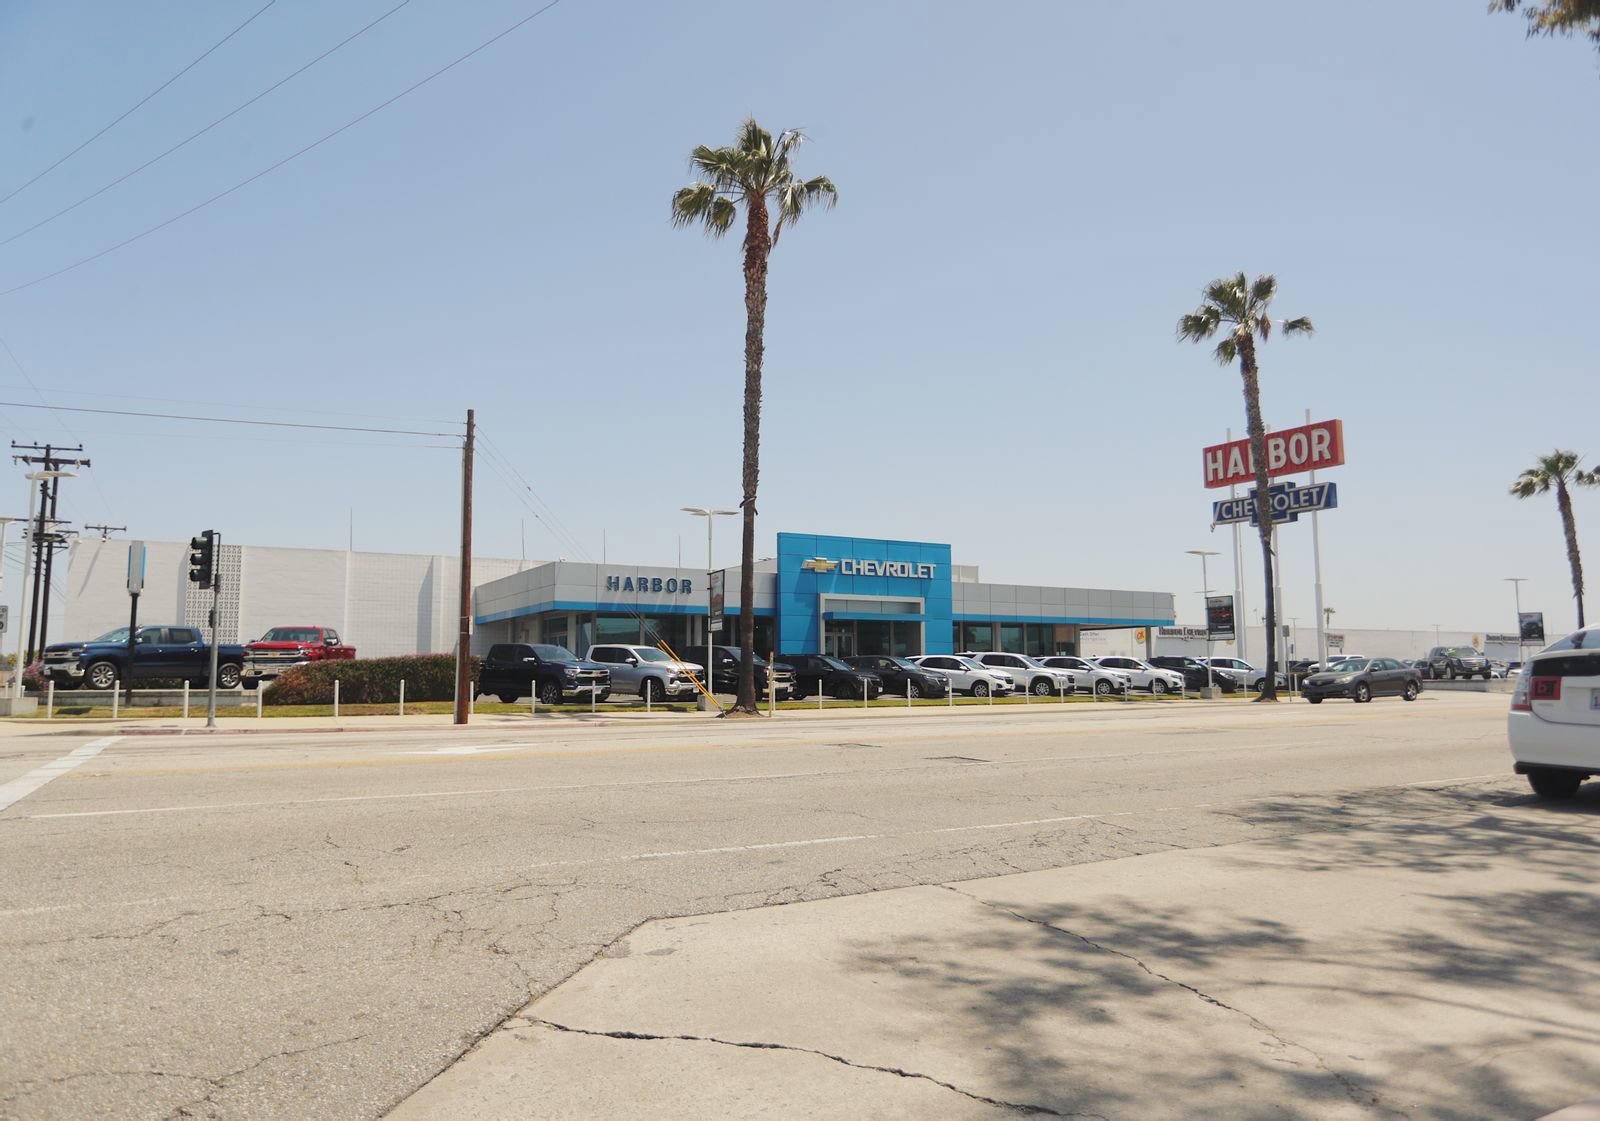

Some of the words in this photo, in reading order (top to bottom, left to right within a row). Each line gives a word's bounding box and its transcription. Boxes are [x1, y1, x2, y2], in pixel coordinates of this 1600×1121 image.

[1206, 428, 1332, 482] HABOR
[1221, 487, 1321, 519] CHEOLET
[841, 558, 937, 579] CHEVROLET
[606, 575, 692, 594] HARBOR
